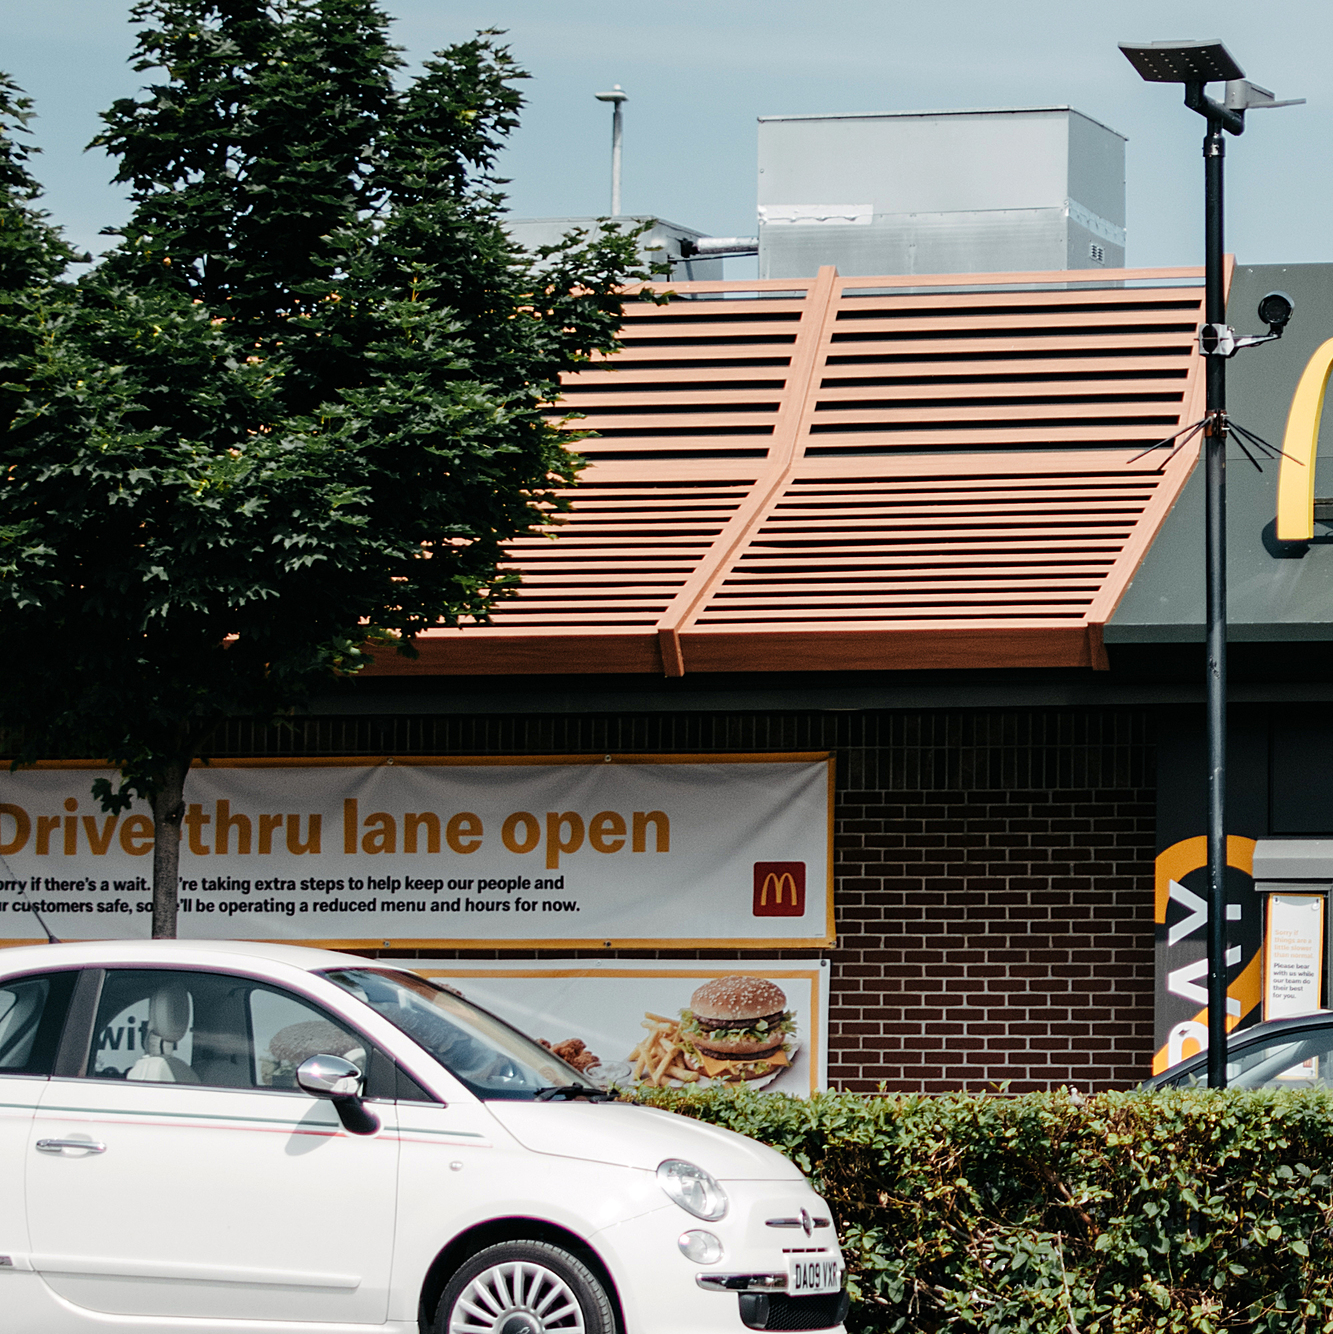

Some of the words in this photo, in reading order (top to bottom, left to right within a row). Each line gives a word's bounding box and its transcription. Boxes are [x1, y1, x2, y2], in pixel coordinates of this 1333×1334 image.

[343, 798, 484, 855] lane
[501, 810, 670, 870] open
[31, 876, 41, 891] if
[45, 877, 97, 892] there's
[101, 880, 109, 891] a
[114, 876, 151, 891] wait.
[202, 876, 251, 895] taking
[255, 877, 296, 891] extra
[300, 877, 345, 895] steps
[348, 877, 364, 890] to
[367, 875, 401, 894] help
[405, 875, 444, 894] keep
[447, 879, 474, 890] our
[478, 875, 531, 894] people
[534, 875, 564, 890] and
[12, 899, 93, 912] customers
[97, 898, 132, 915] safe,
[136, 901, 154, 913] so
[196, 898, 215, 912] be
[219, 897, 295, 916] operating
[300, 901, 308, 912] a
[313, 897, 377, 912] reduced
[381, 901, 426, 912] menu
[430, 897, 461, 912] and
[465, 897, 511, 912] hours
[515, 897, 538, 912] for
[542, 900, 581, 912] now.
